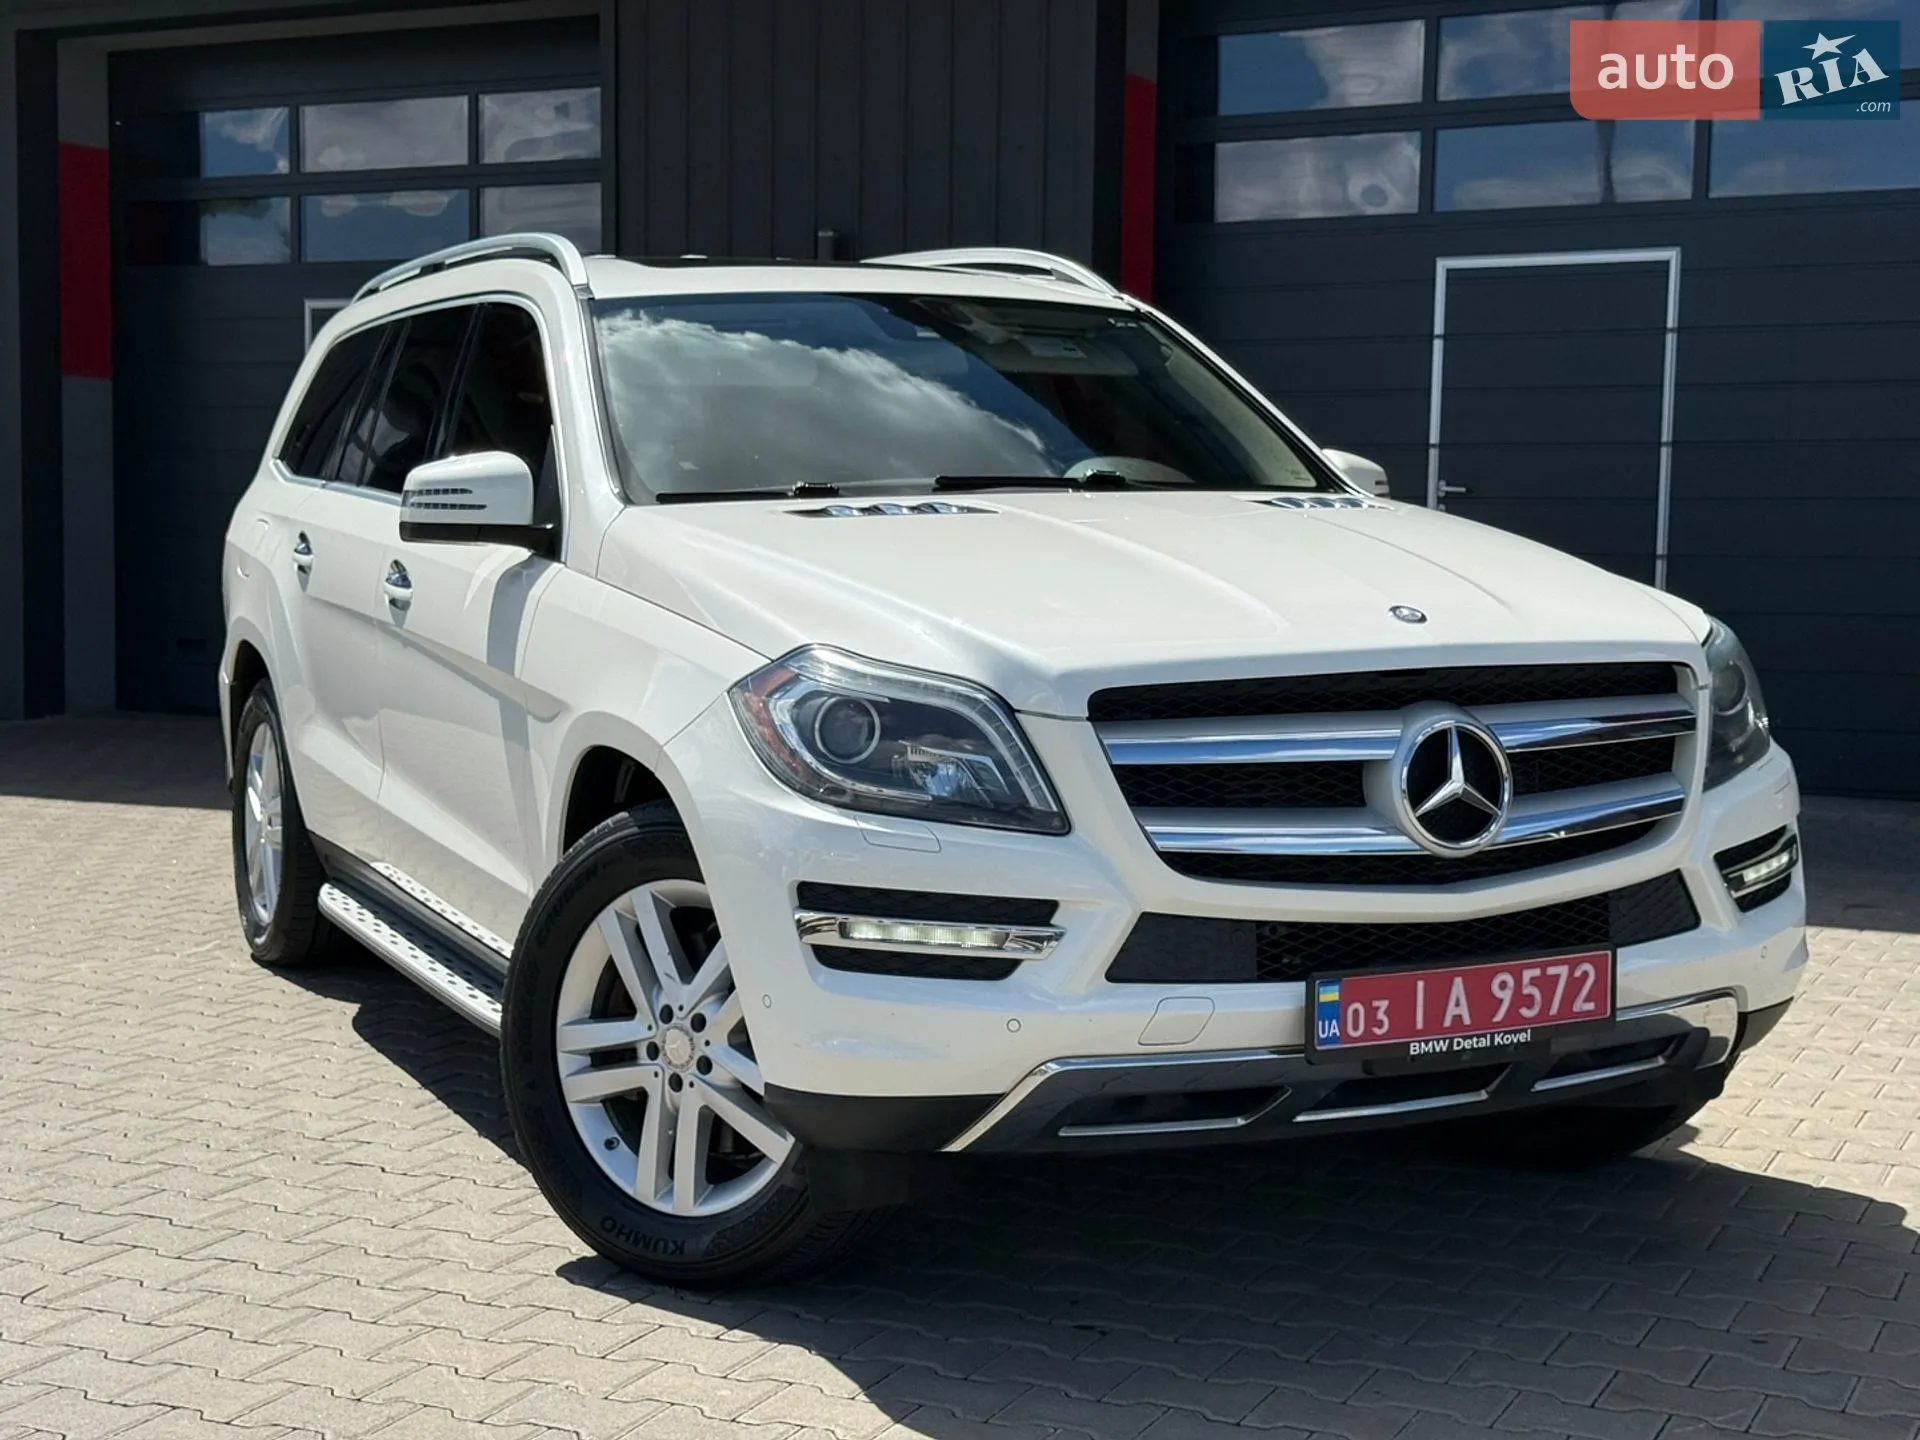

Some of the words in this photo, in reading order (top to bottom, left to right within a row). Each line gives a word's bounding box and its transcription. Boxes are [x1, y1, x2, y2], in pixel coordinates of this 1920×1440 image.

[1346, 1000, 1390, 1038] 03
[1490, 961, 1597, 1023] 9572
[1318, 1019, 1340, 1039] UA
[1409, 1039, 1449, 1056] BMW
[1453, 1034, 1491, 1051] Detal
[1494, 1028, 1532, 1046] Kovel
[600, 1215, 686, 1256] KUMHO
